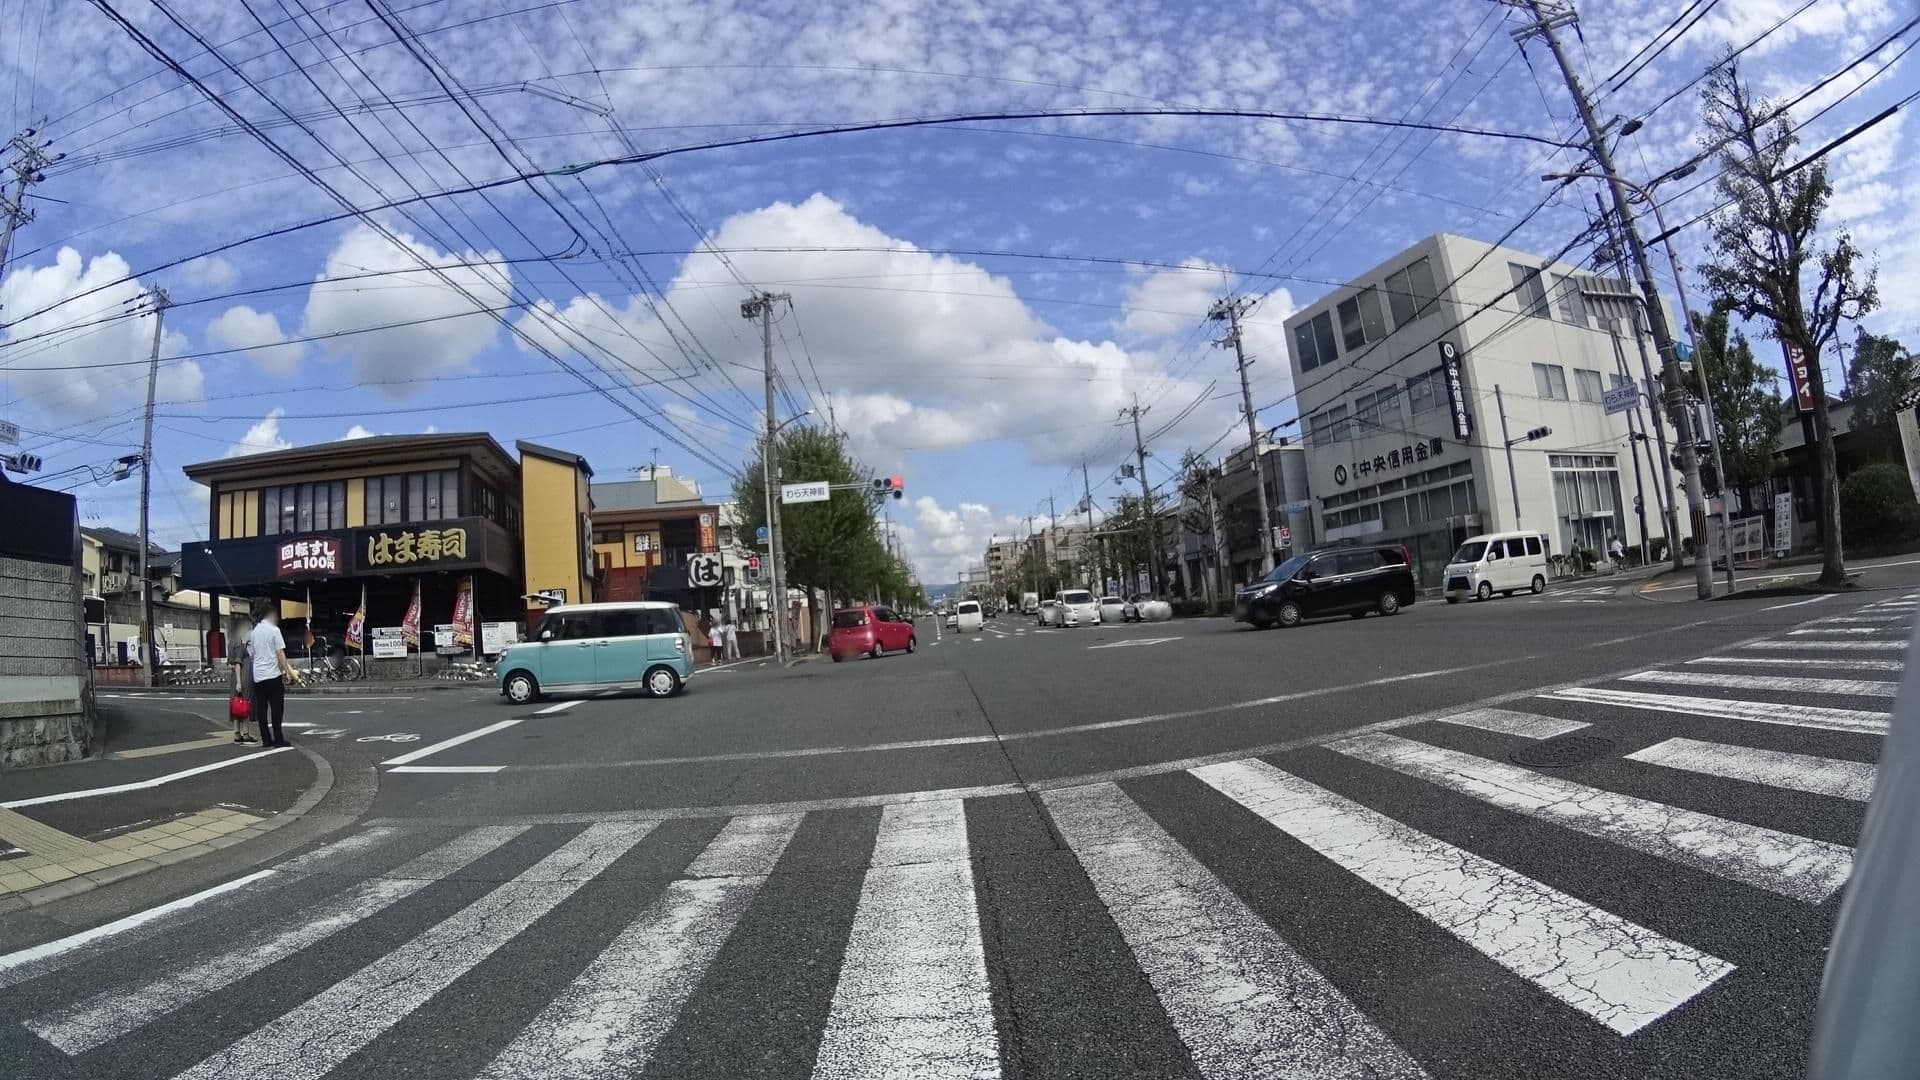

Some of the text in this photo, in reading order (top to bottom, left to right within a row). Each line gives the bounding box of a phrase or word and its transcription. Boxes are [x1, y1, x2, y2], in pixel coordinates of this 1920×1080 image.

[786, 487, 825, 499] わら天神前
[281, 541, 335, 561] 回転すし
[367, 528, 467, 566] はま寿司
[692, 556, 720, 585] は
